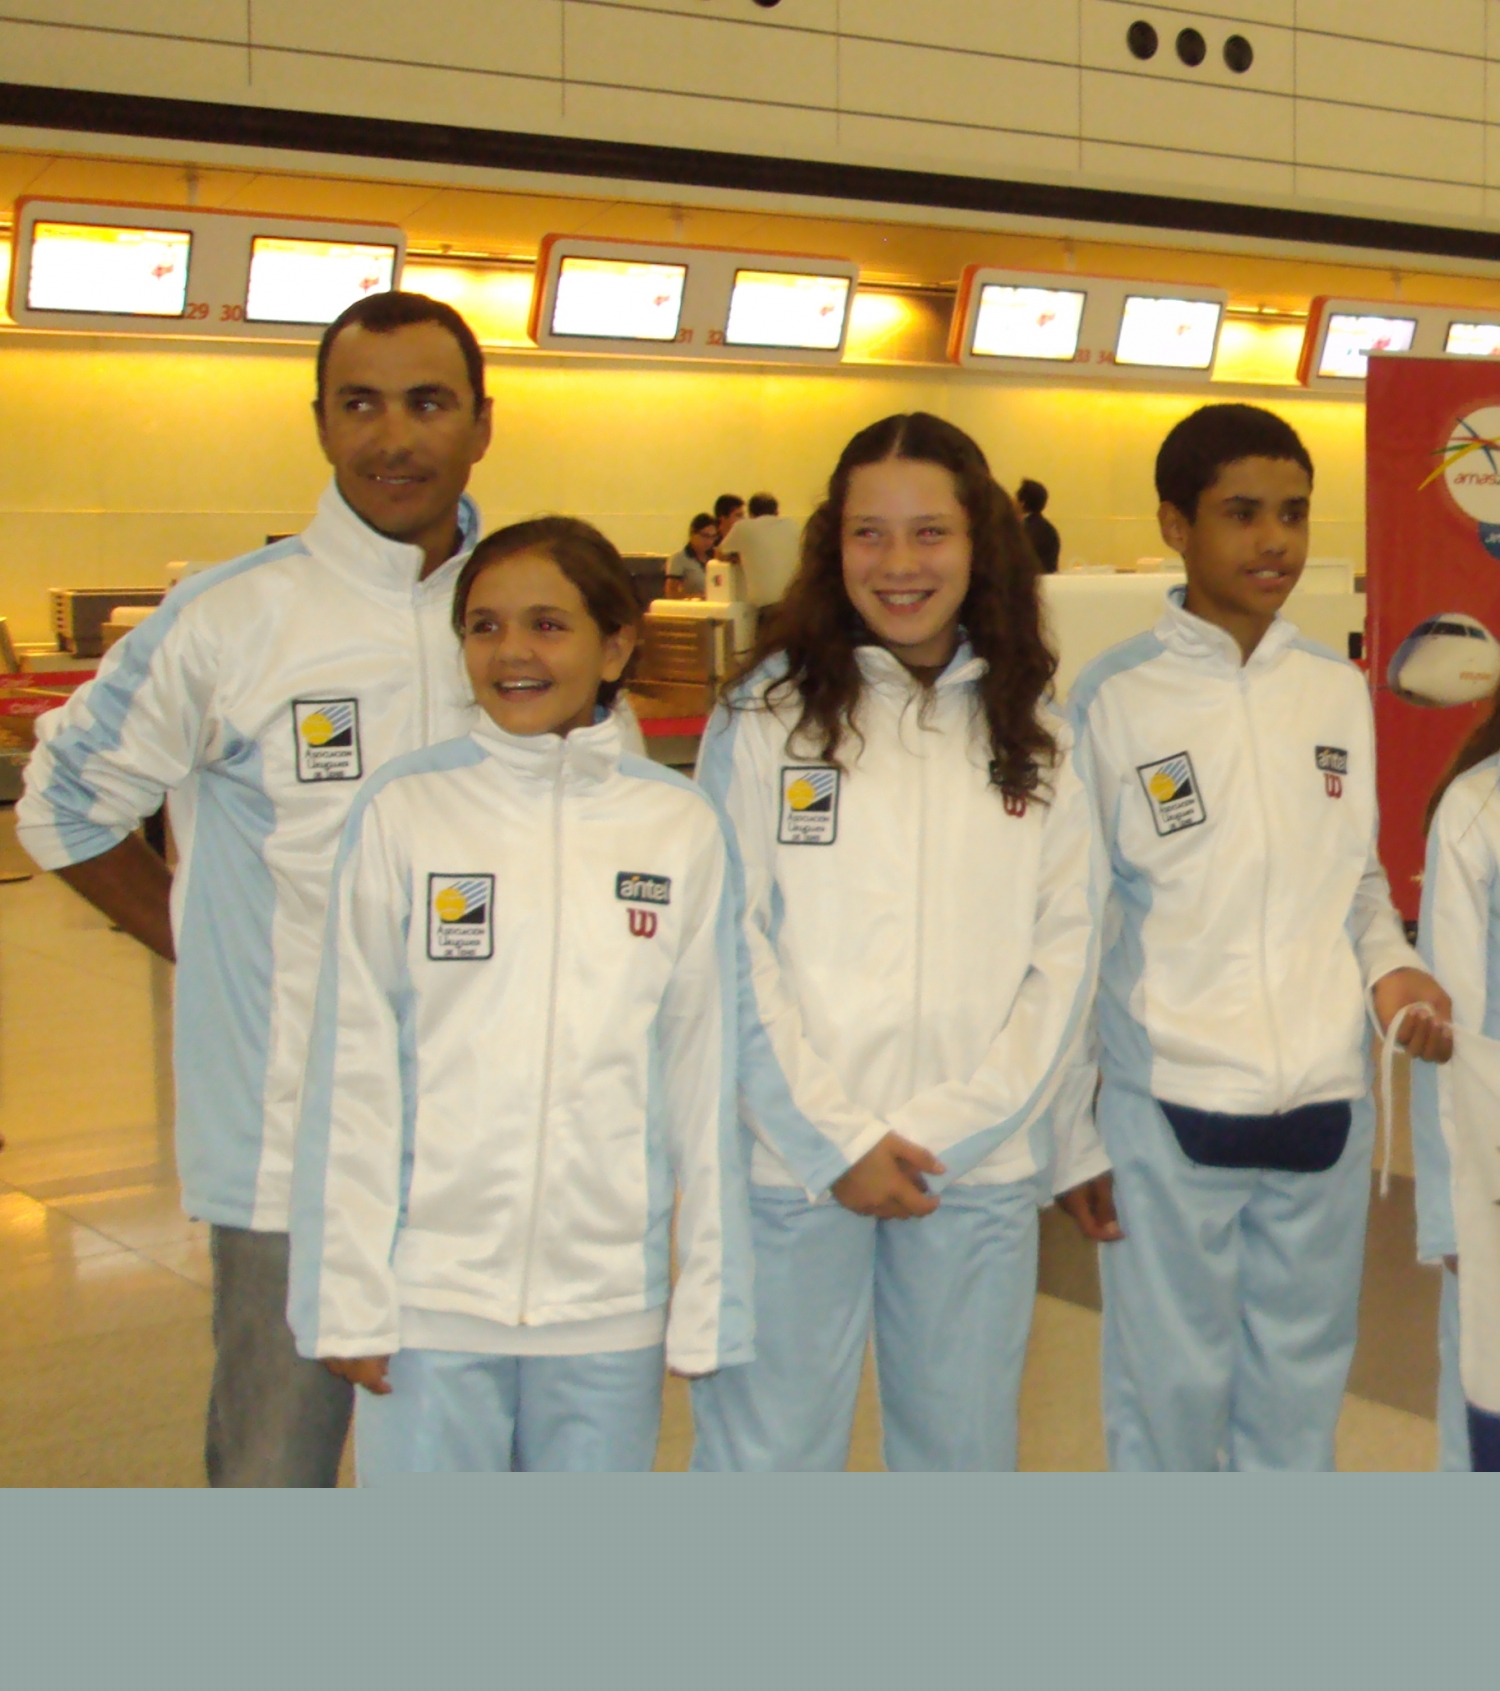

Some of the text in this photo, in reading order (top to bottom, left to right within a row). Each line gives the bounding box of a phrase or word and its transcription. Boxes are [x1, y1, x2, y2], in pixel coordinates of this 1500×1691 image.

[186, 302, 210, 320] 29
[220, 304, 243, 322] 30
[676, 328, 694, 344] 31
[705, 329, 724, 346] 32
[620, 875, 670, 901] antel
